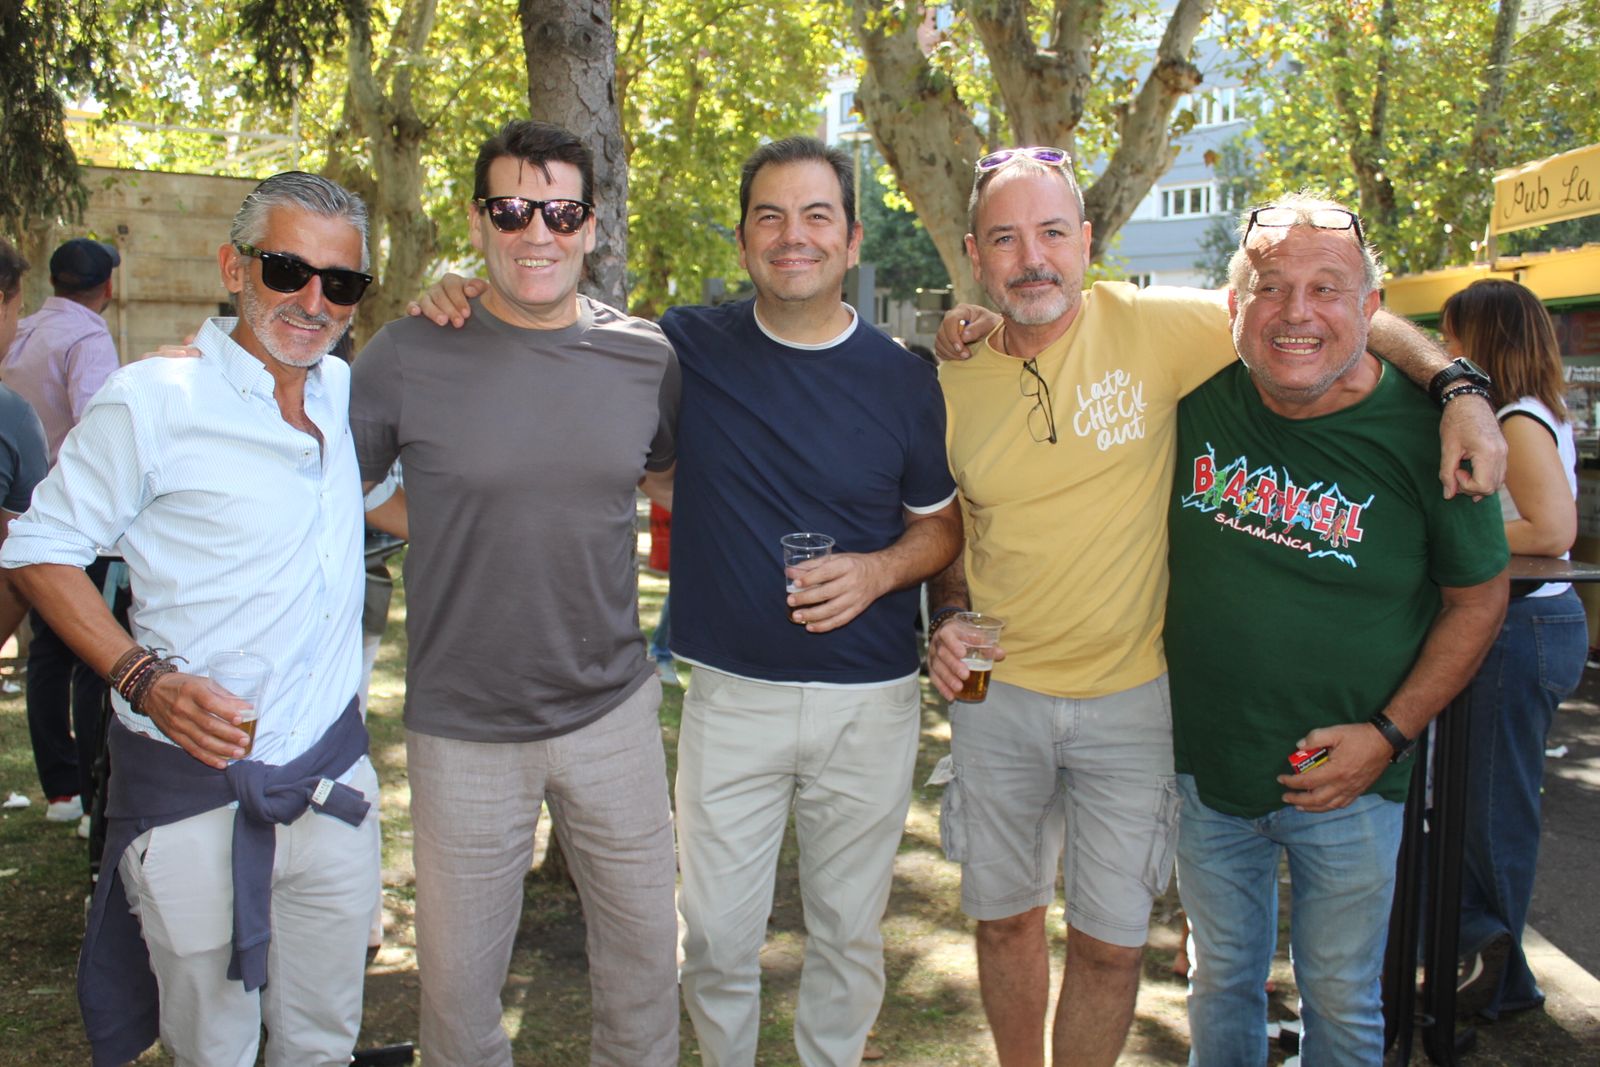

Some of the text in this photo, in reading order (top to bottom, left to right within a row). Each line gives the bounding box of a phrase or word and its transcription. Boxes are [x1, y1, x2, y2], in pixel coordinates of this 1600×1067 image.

[1504, 165, 1592, 219] Pub La
[1073, 380, 1148, 437] CHECK
[1076, 369, 1131, 411] Late
[1096, 412, 1146, 451] out
[1193, 454, 1364, 543] BARVEL
[1214, 513, 1312, 552] SALAMANCA
